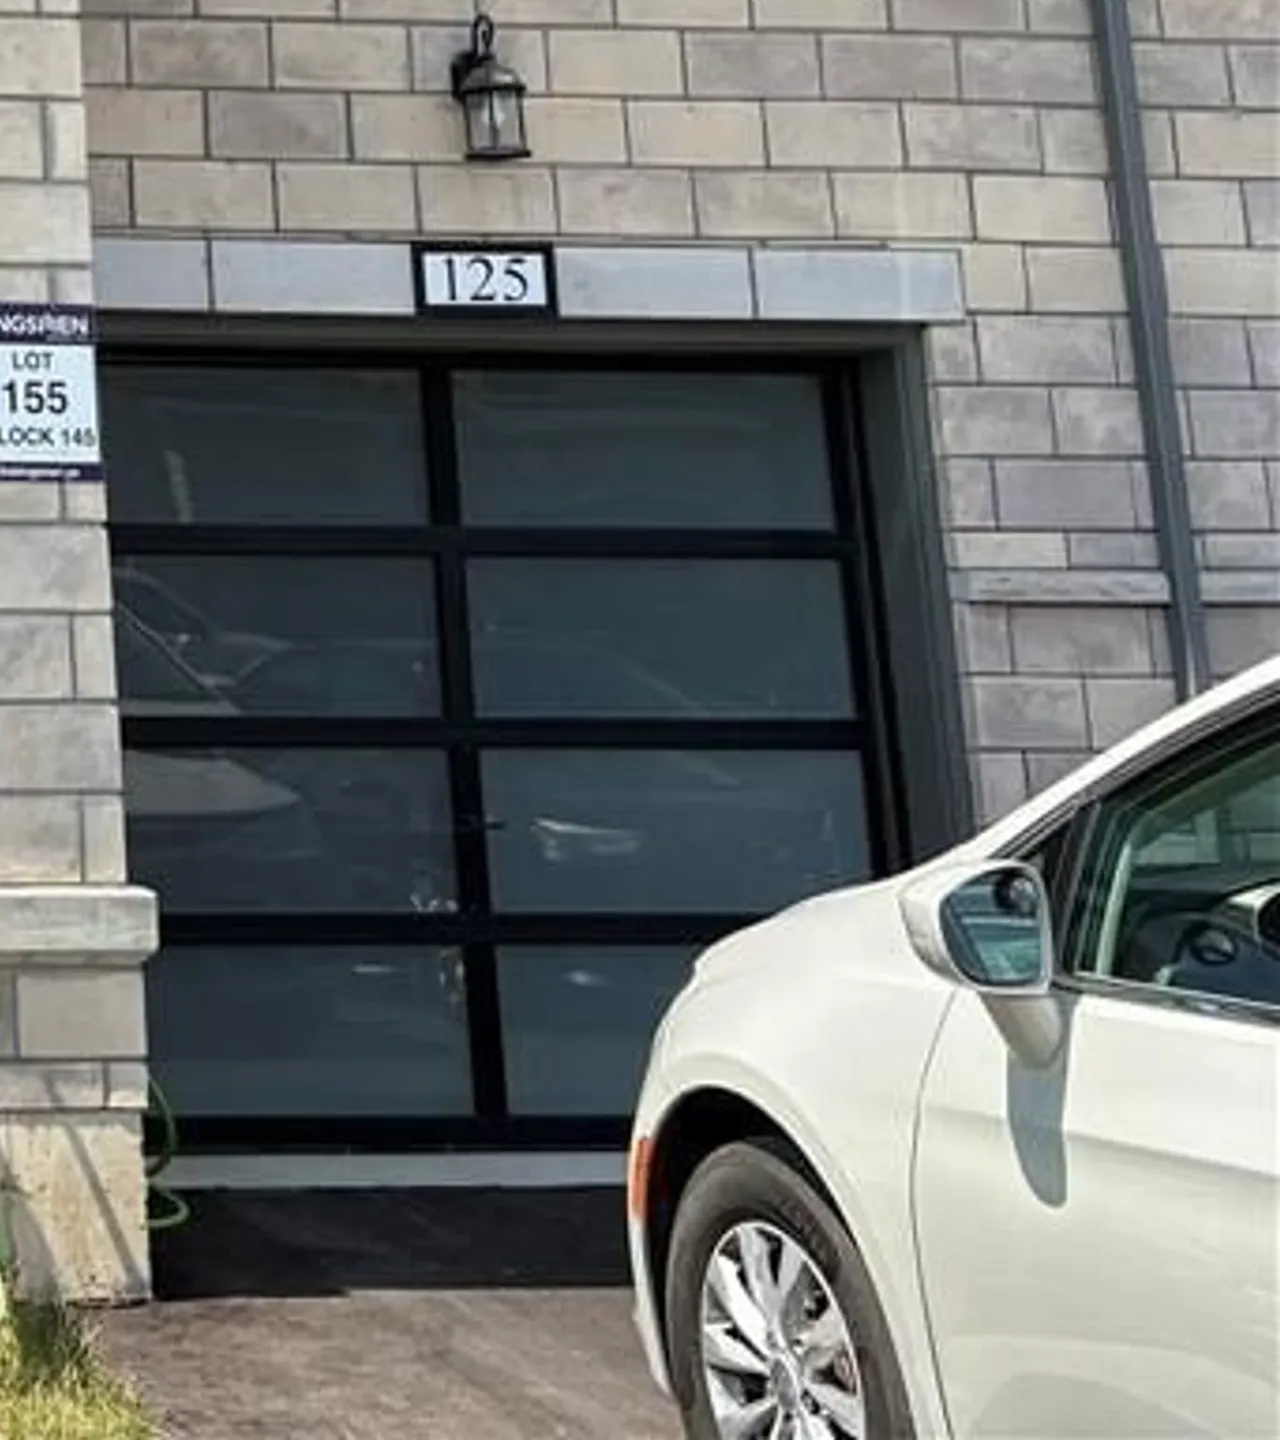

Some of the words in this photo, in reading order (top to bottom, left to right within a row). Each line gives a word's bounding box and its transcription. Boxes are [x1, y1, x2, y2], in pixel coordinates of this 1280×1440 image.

[444, 257, 529, 302] 125
[12, 351, 55, 371] LOT
[2, 379, 67, 414] 155
